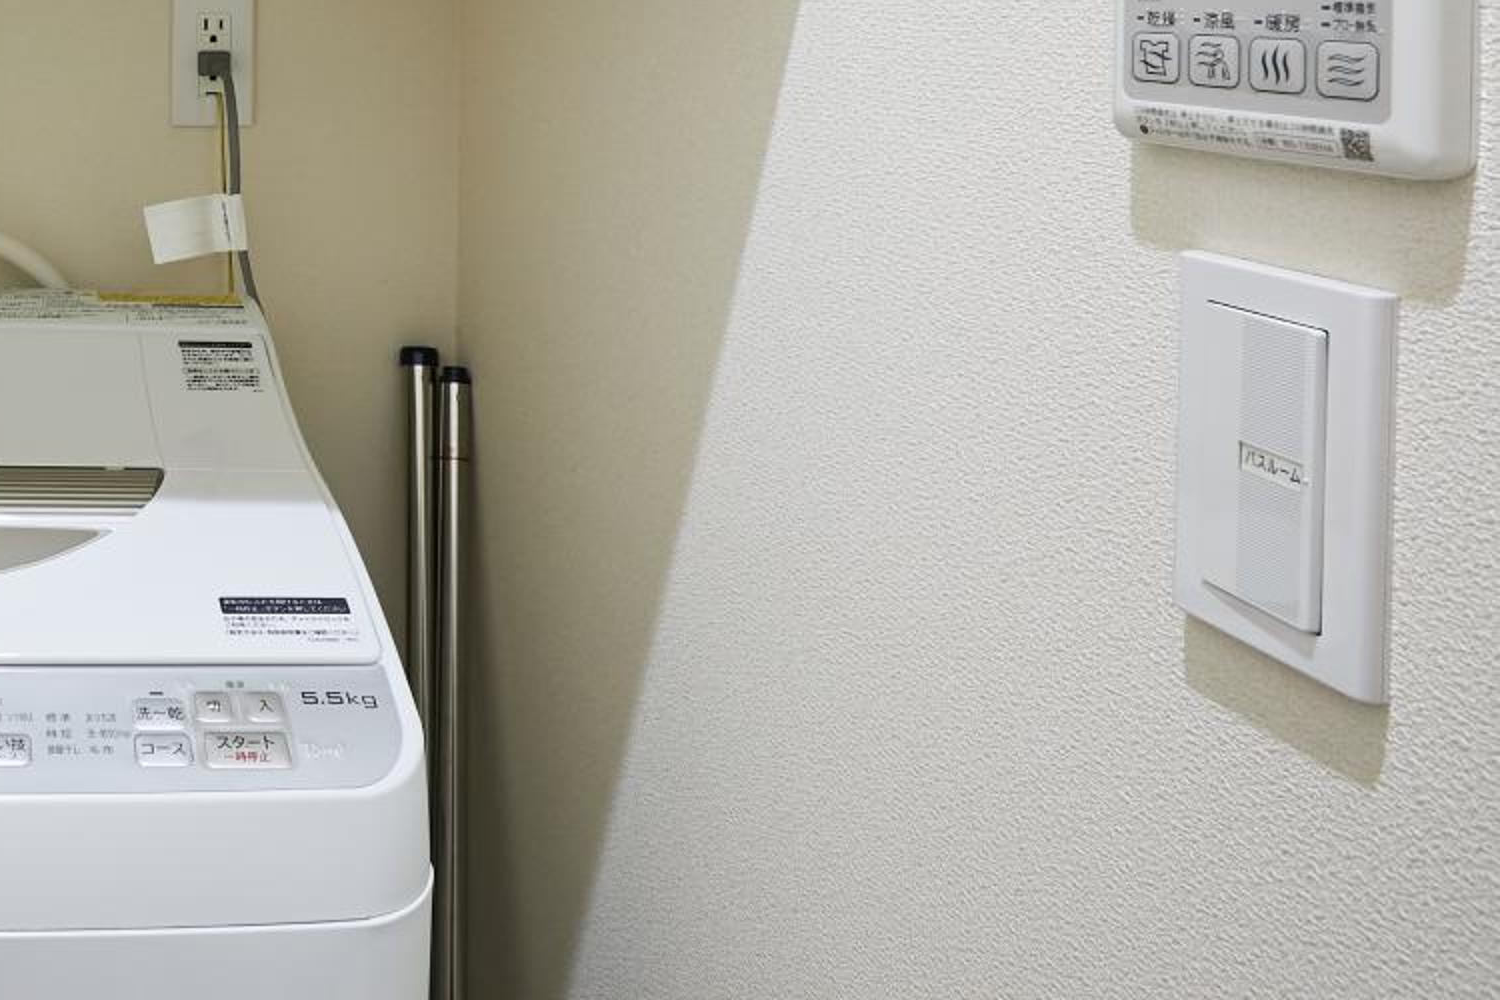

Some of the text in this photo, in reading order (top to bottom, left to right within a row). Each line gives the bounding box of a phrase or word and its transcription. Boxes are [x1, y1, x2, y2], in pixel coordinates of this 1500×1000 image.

[259, 699, 274, 713] 入
[301, 691, 379, 709] 5.5kg
[141, 742, 187, 756] コース
[216, 734, 275, 750] スタート
